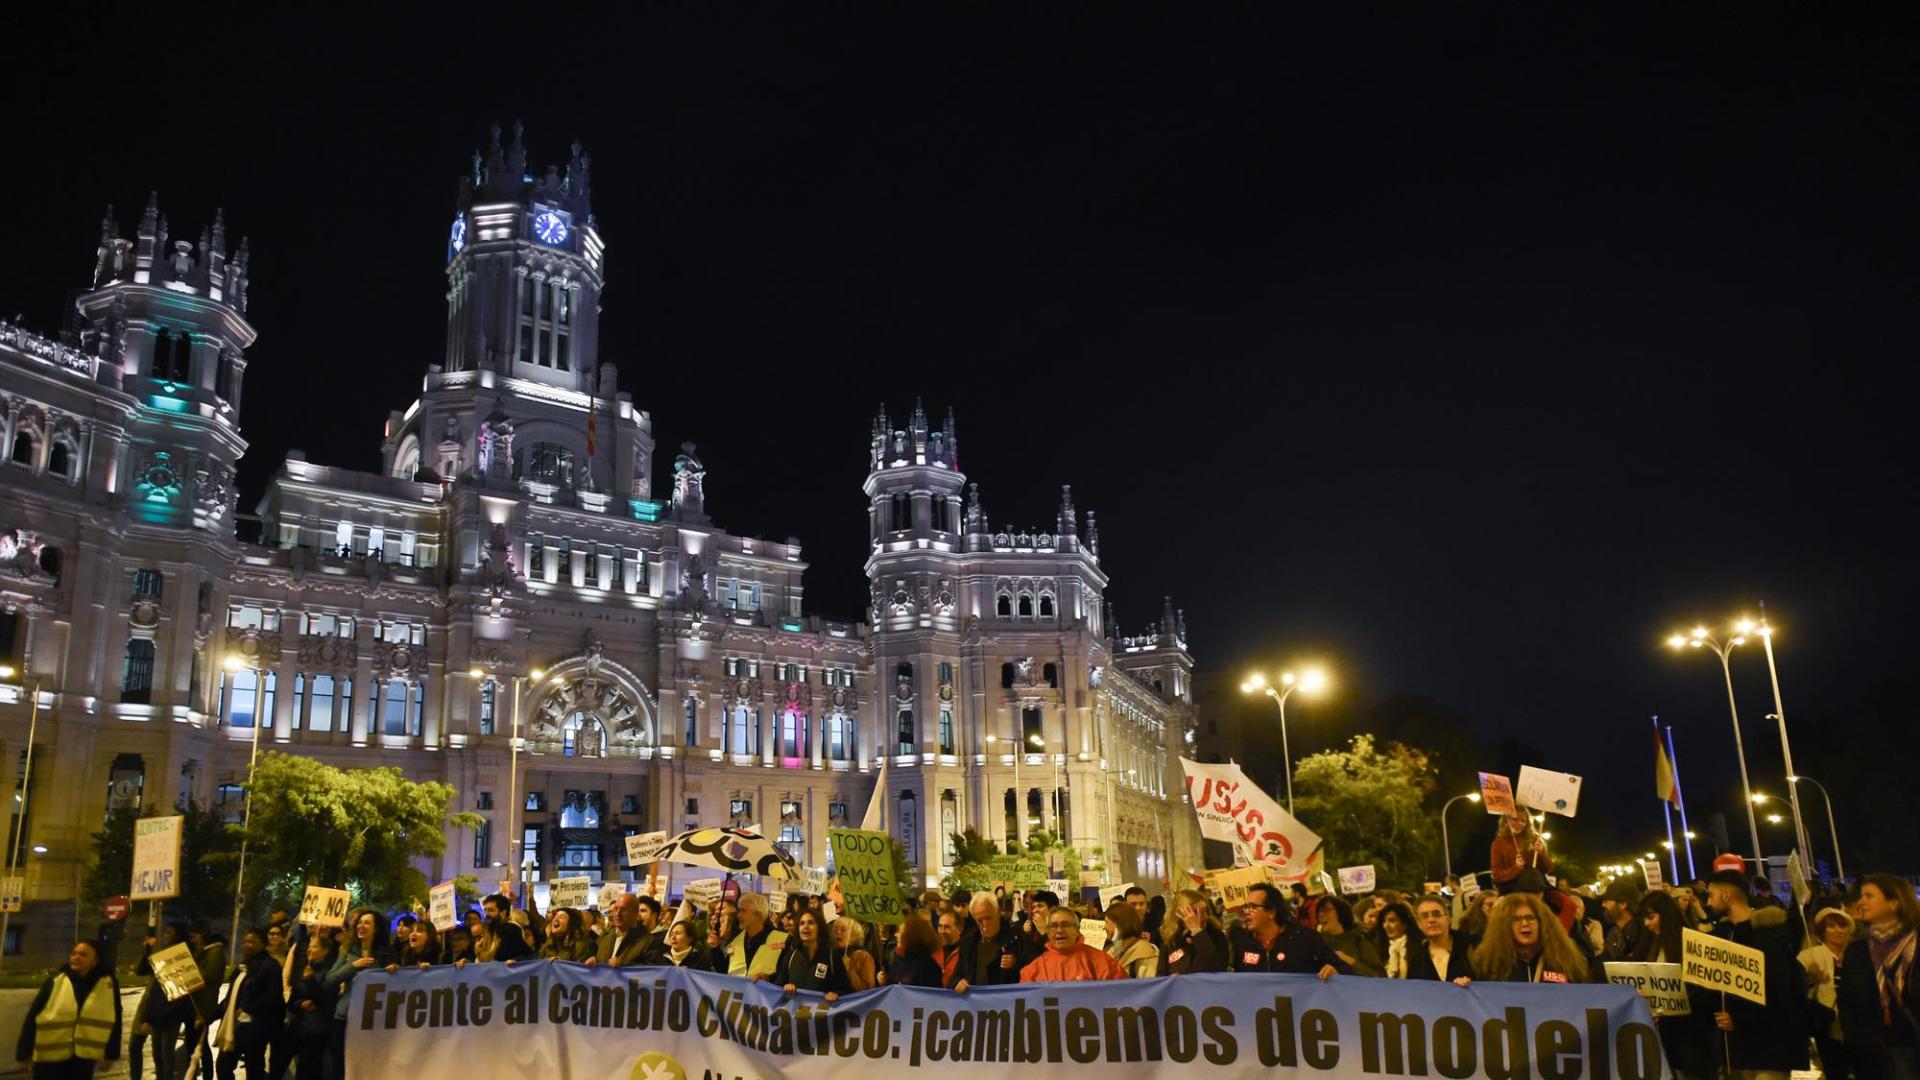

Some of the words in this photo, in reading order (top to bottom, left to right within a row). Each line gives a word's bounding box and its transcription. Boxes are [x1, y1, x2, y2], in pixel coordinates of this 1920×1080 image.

[833, 833, 885, 855] TODO
[840, 865, 889, 886] AMAS
[844, 892, 900, 915] PELIGRO
[1649, 976, 1681, 992] NOW
[1686, 961, 1731, 985] MENOS
[361, 982, 493, 1030] Frente
[504, 976, 539, 1025] al
[548, 979, 691, 1033] cambio
[697, 988, 902, 1059] climático:
[909, 997, 1238, 1067] ¡cambiemos
[1255, 996, 1341, 1071] de
[1359, 1006, 1662, 1080] modelo
